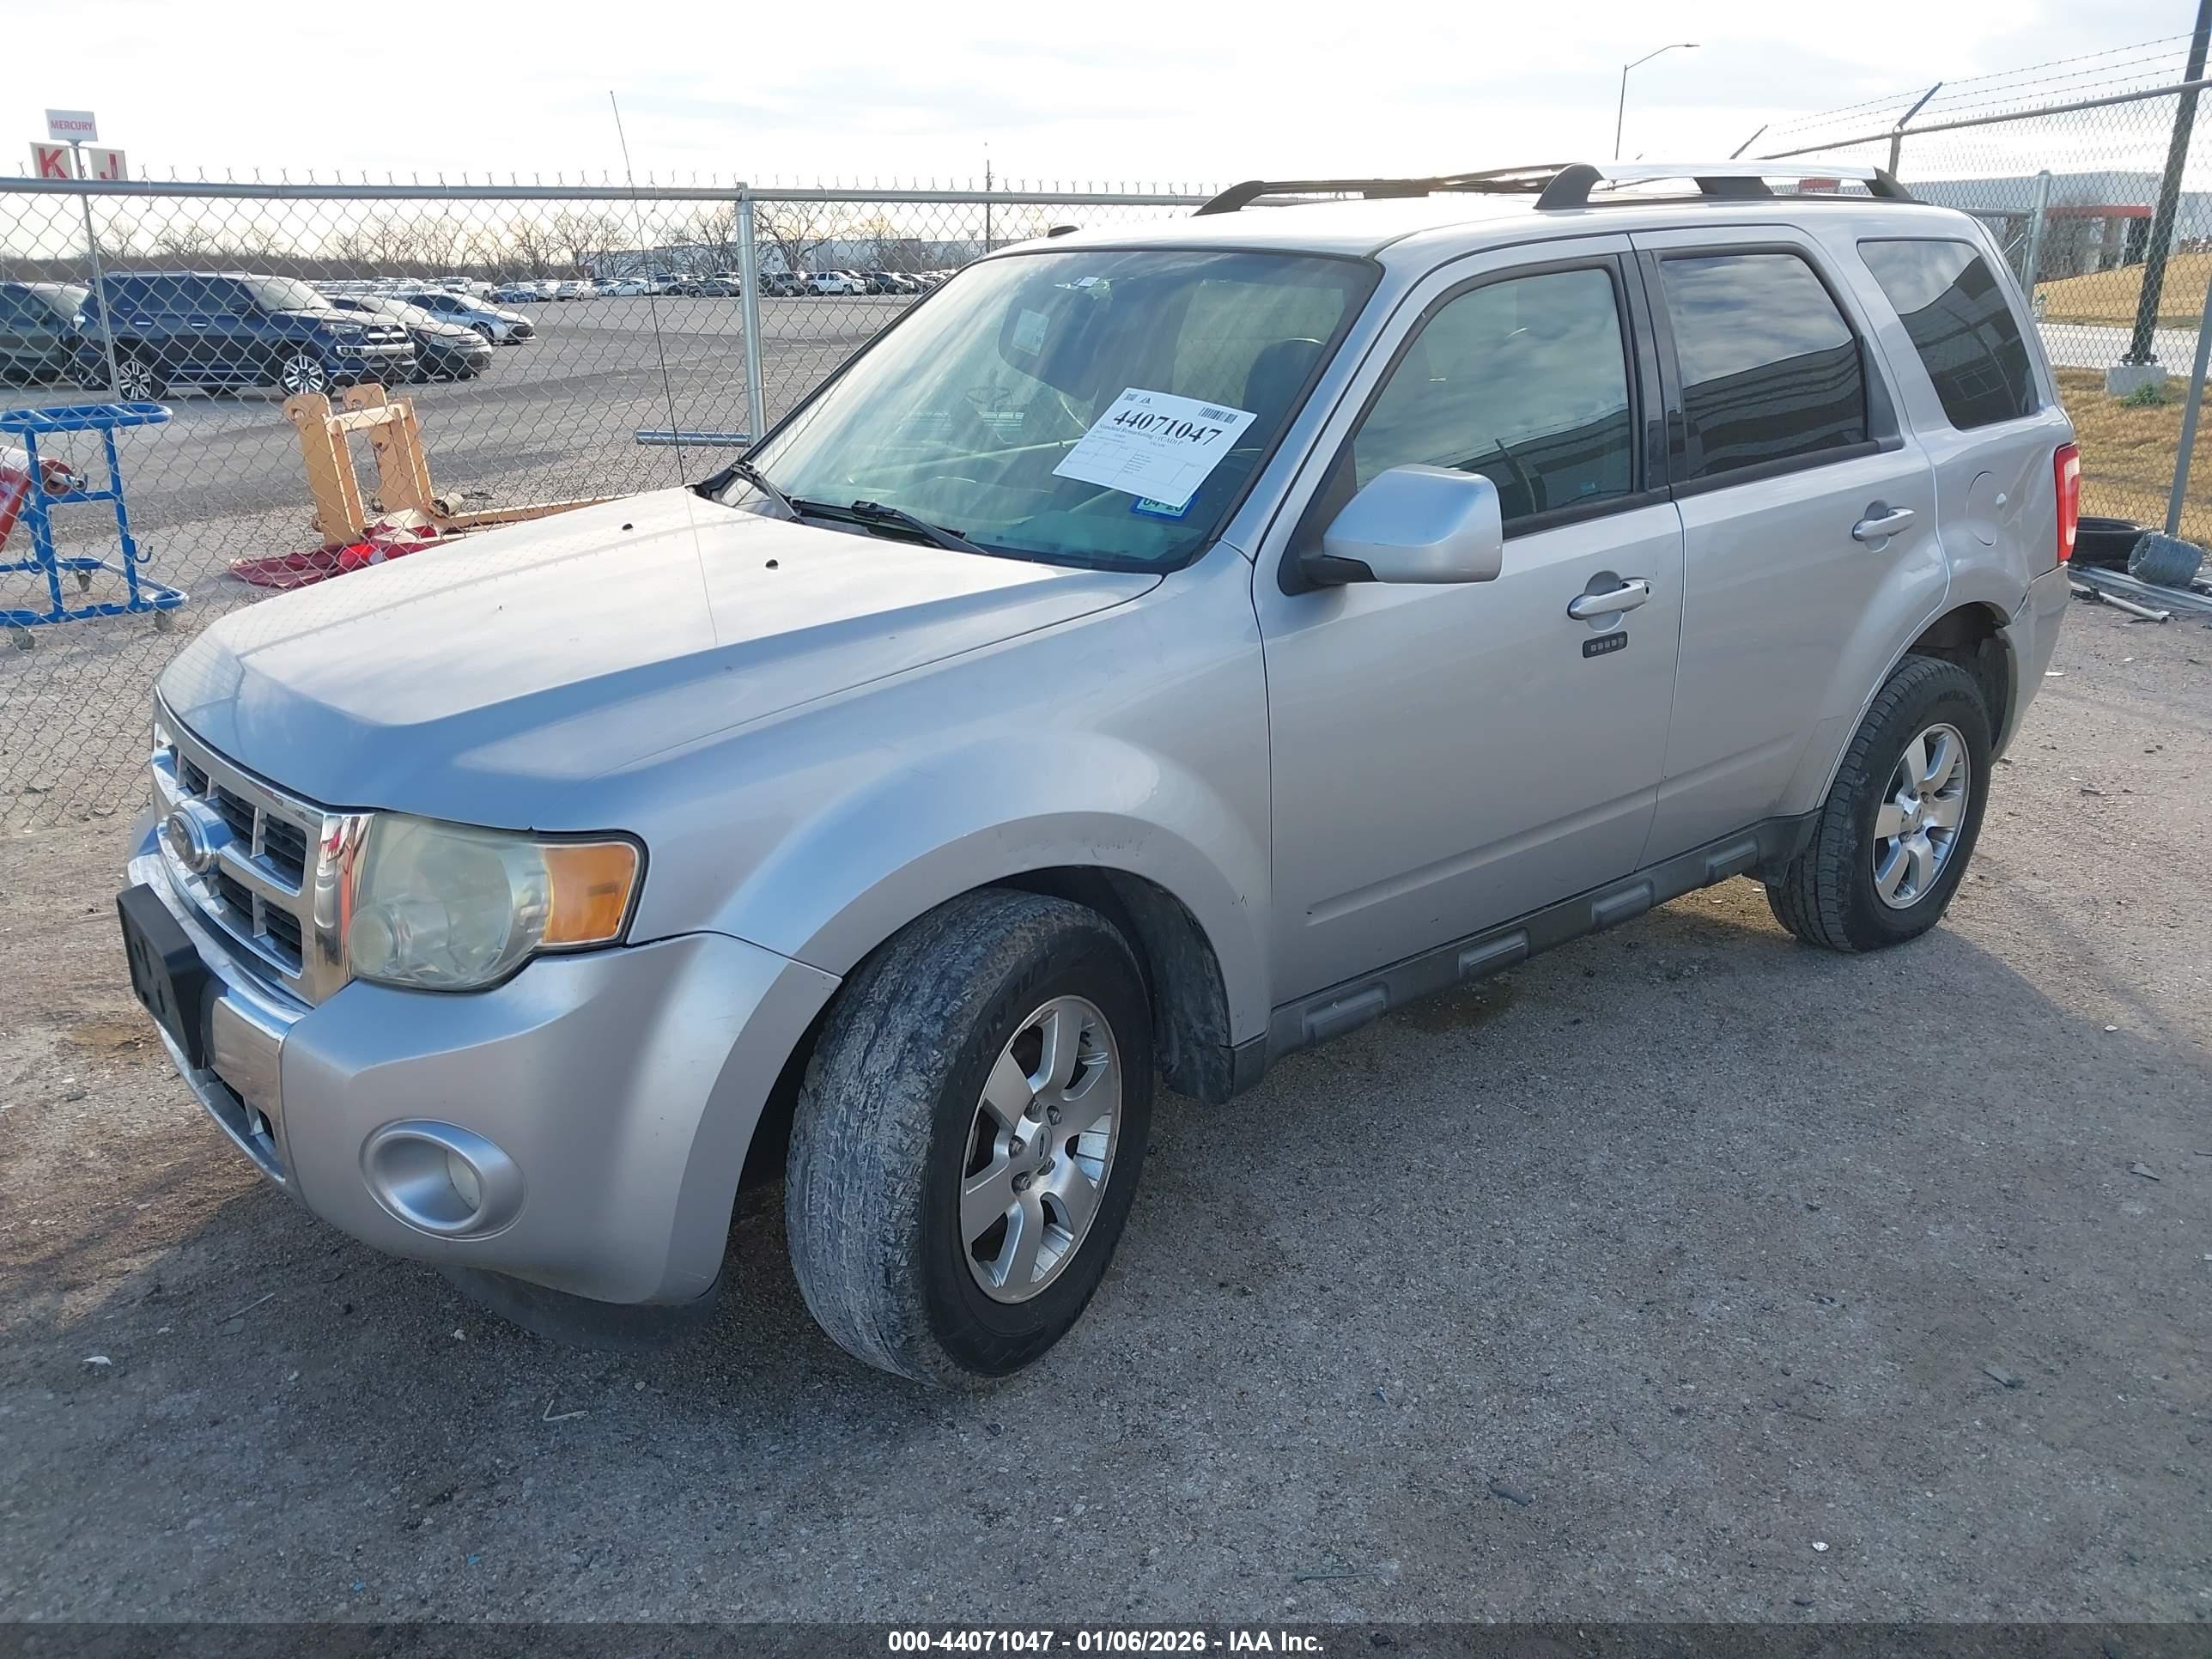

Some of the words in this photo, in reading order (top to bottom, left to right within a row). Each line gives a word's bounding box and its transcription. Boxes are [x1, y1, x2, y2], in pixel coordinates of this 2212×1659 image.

[52, 120, 93, 131] MERCURY
[38, 148, 68, 179] K
[99, 154, 118, 179] J
[1113, 410, 1223, 446] 44071047
